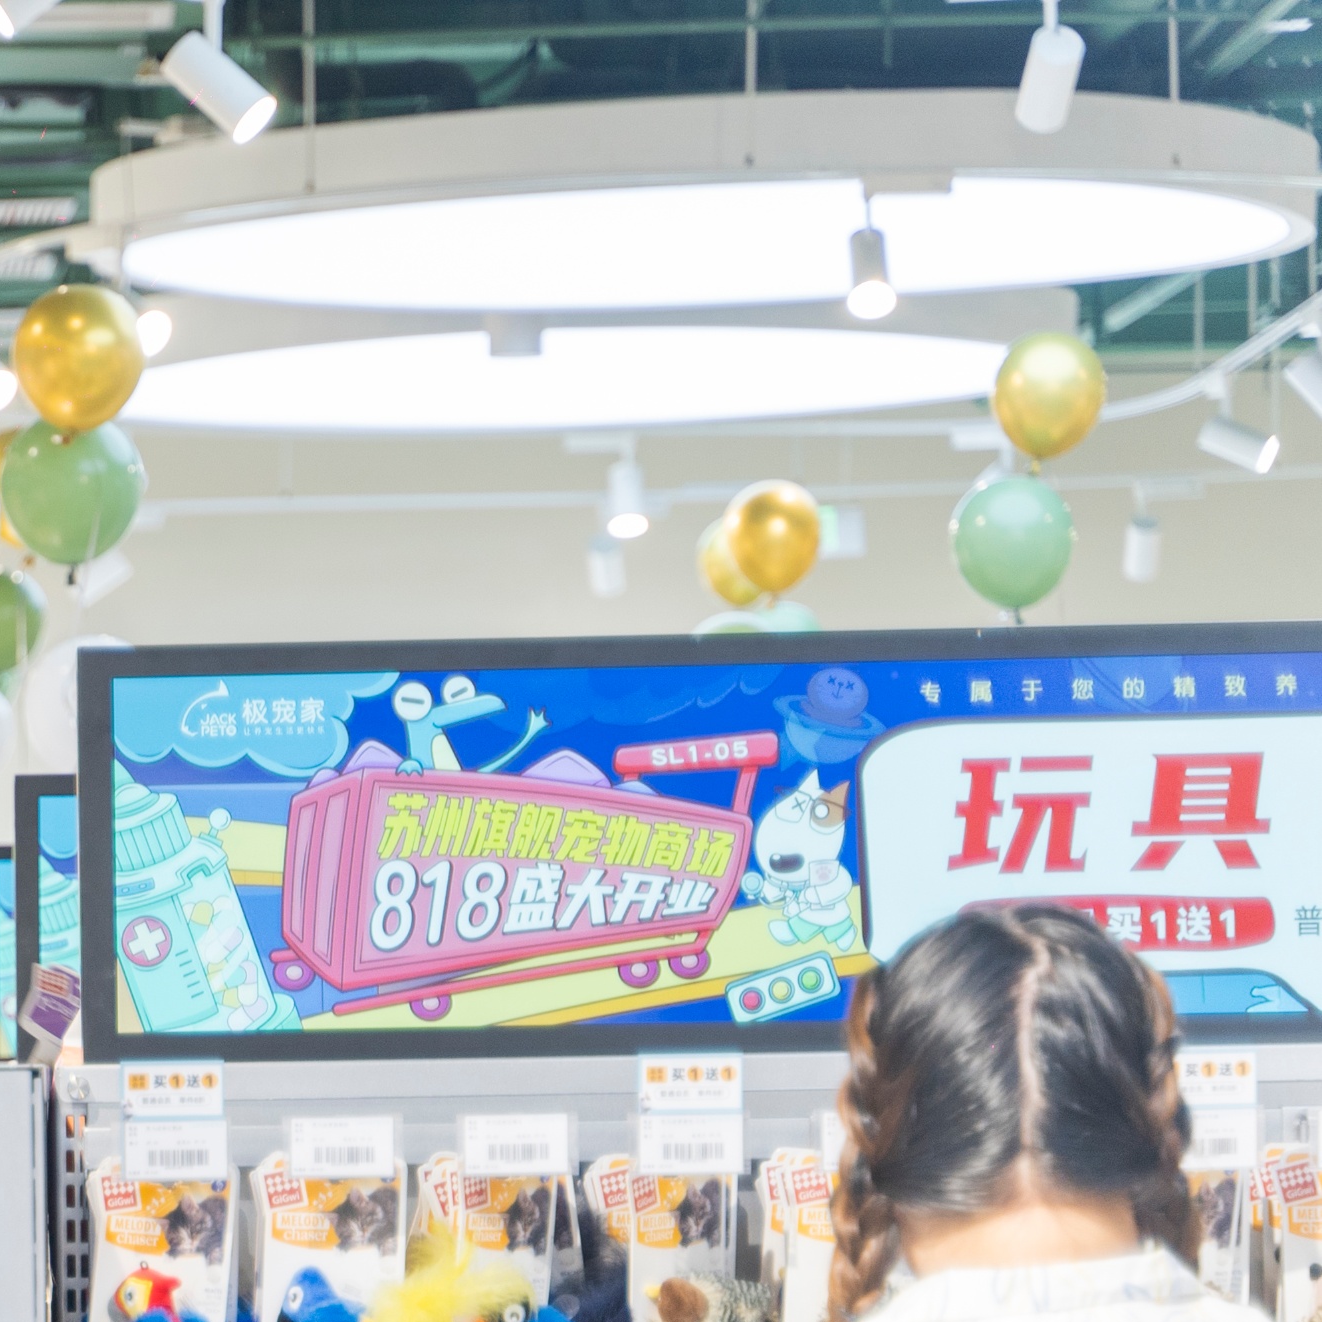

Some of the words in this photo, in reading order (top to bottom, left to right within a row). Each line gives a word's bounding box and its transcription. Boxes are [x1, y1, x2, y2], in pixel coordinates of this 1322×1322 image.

[920, 674, 1298, 704] 专属于您的精致养
[200, 712, 237, 724] JACK
[242, 697, 325, 724] 极宠家
[201, 726, 237, 737] PETO
[651, 739, 749, 767] SL1-05
[947, 752, 1272, 875] 玩具
[377, 792, 736, 878] 苏州旗舰宠物商场
[369, 860, 717, 952] 818盛大开业
[1087, 905, 1237, 942] 买1送1
[1294, 906, 1322, 937] 普
[153, 1074, 214, 1089] 买1送1
[672, 1067, 733, 1081] 买1送1
[108, 1196, 134, 1208] GiGwi
[272, 1192, 300, 1205] GiGwi
[114, 1217, 158, 1231] MELODY
[280, 1216, 327, 1229] MELODY
[116, 1232, 159, 1247] chaser
[283, 1227, 328, 1242] chaser
